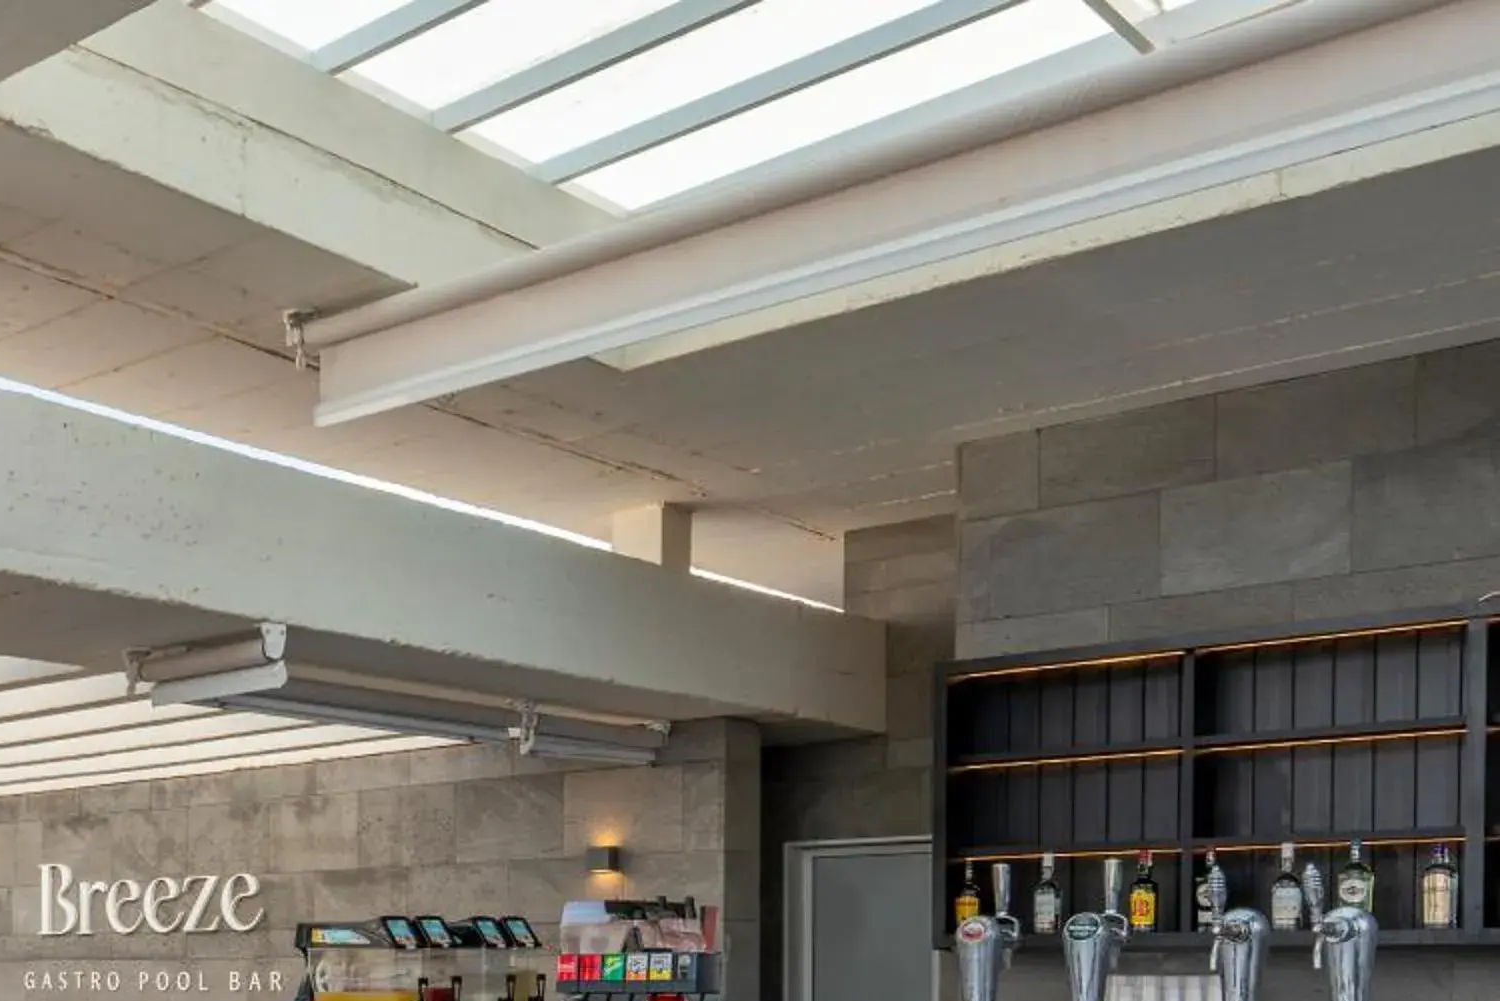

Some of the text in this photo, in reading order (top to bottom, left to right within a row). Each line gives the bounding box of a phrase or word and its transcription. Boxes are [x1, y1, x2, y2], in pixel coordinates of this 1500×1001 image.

[36, 863, 264, 936] Breeze
[24, 971, 283, 991] GASTRO POOL BAR
